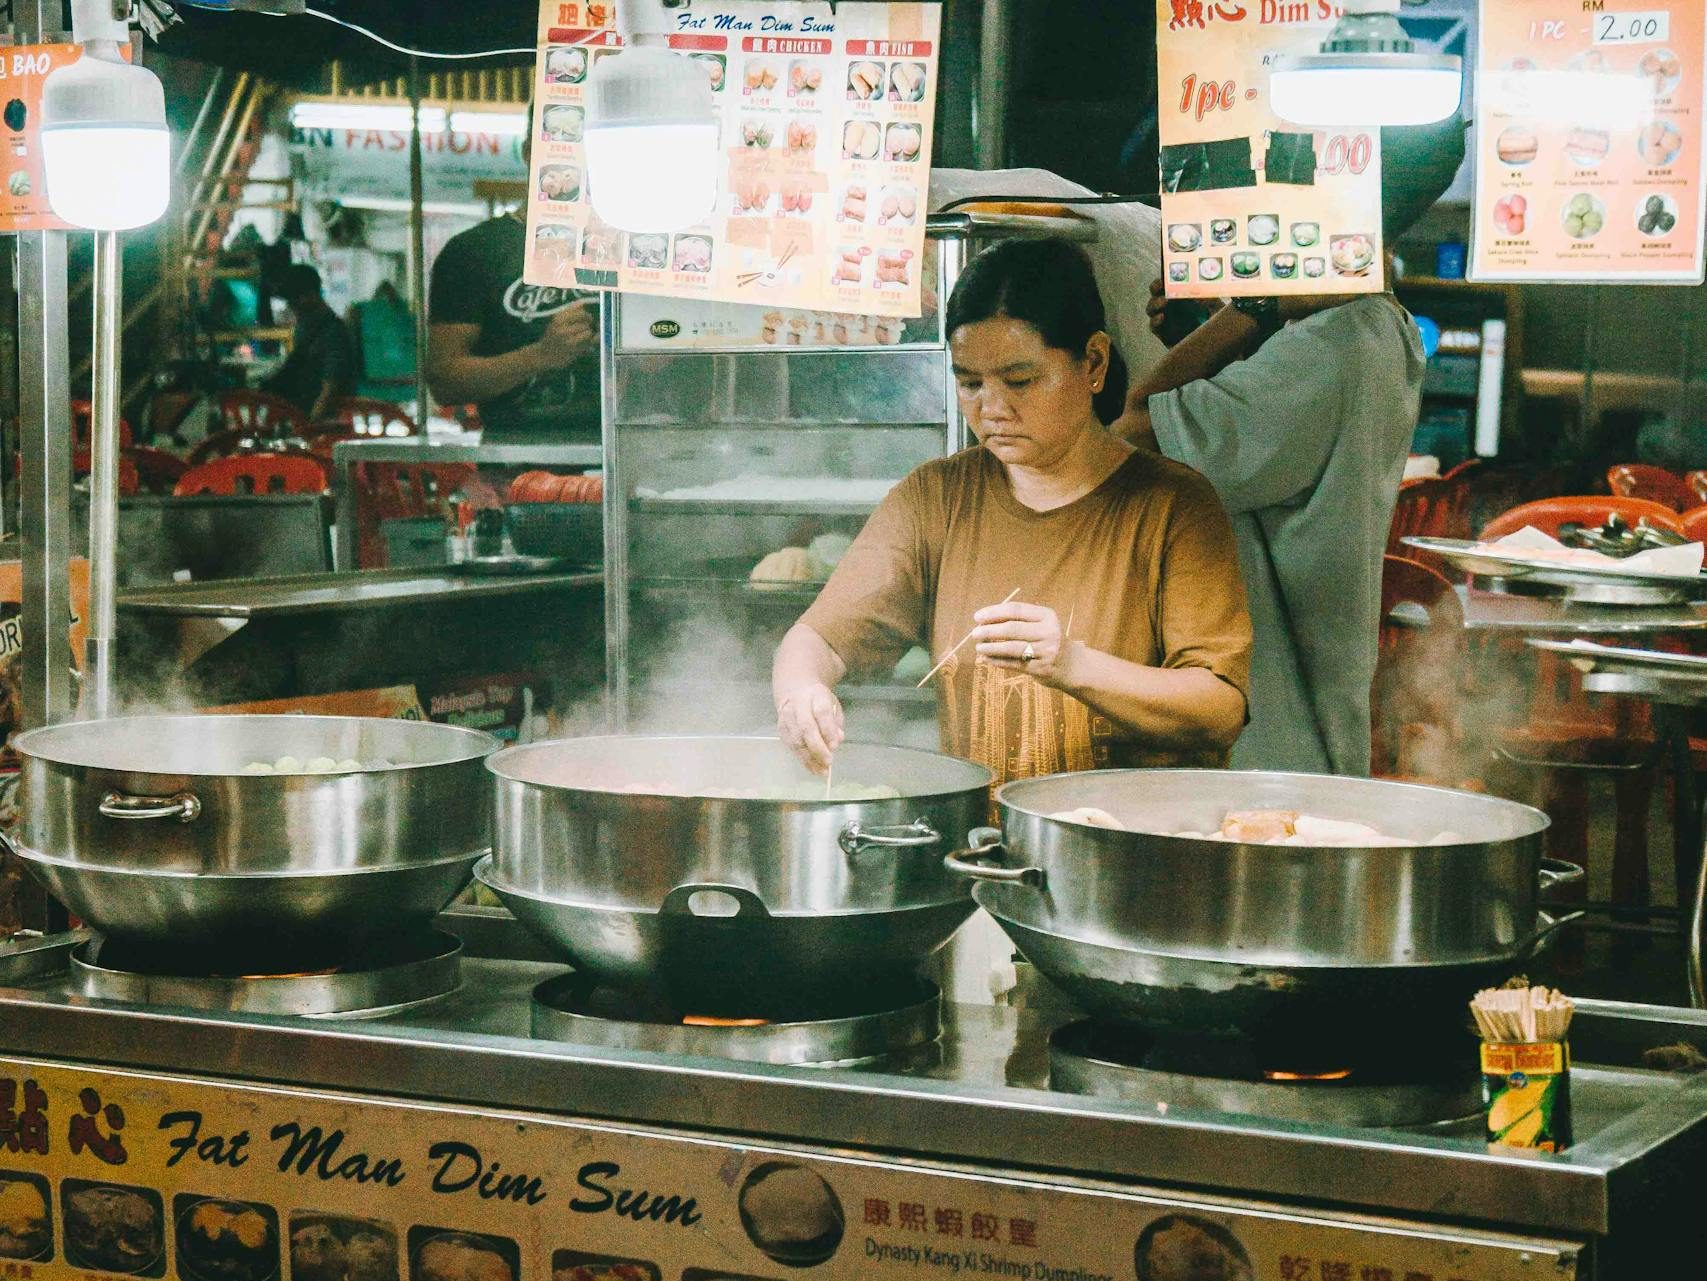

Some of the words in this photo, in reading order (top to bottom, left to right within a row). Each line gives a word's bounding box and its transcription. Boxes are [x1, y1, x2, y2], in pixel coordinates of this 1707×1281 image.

[1260, 0, 1309, 24] Dim
[1582, 0, 1604, 11] RM
[677, 13, 707, 31] Fat
[713, 14, 753, 31] Man
[761, 15, 794, 31] Dim
[800, 16, 836, 33] Sum
[1600, 15, 1659, 41] 2.00
[779, 39, 823, 54] CHICKEN
[891, 42, 914, 56] FISH
[13, 53, 51, 76] BAO
[1179, 73, 1236, 122] 1pc
[345, 128, 499, 156] FASHION
[650, 322, 679, 335] MSM
[158, 1110, 250, 1168] Fat
[270, 1121, 406, 1186] Man
[428, 1141, 548, 1207] Dim
[568, 1161, 702, 1228] Sum
[865, 1236, 921, 1263] Dynasty
[923, 1245, 960, 1273] Kang
[963, 1251, 978, 1272] Xi
[980, 1253, 1030, 1281] Shrimp
